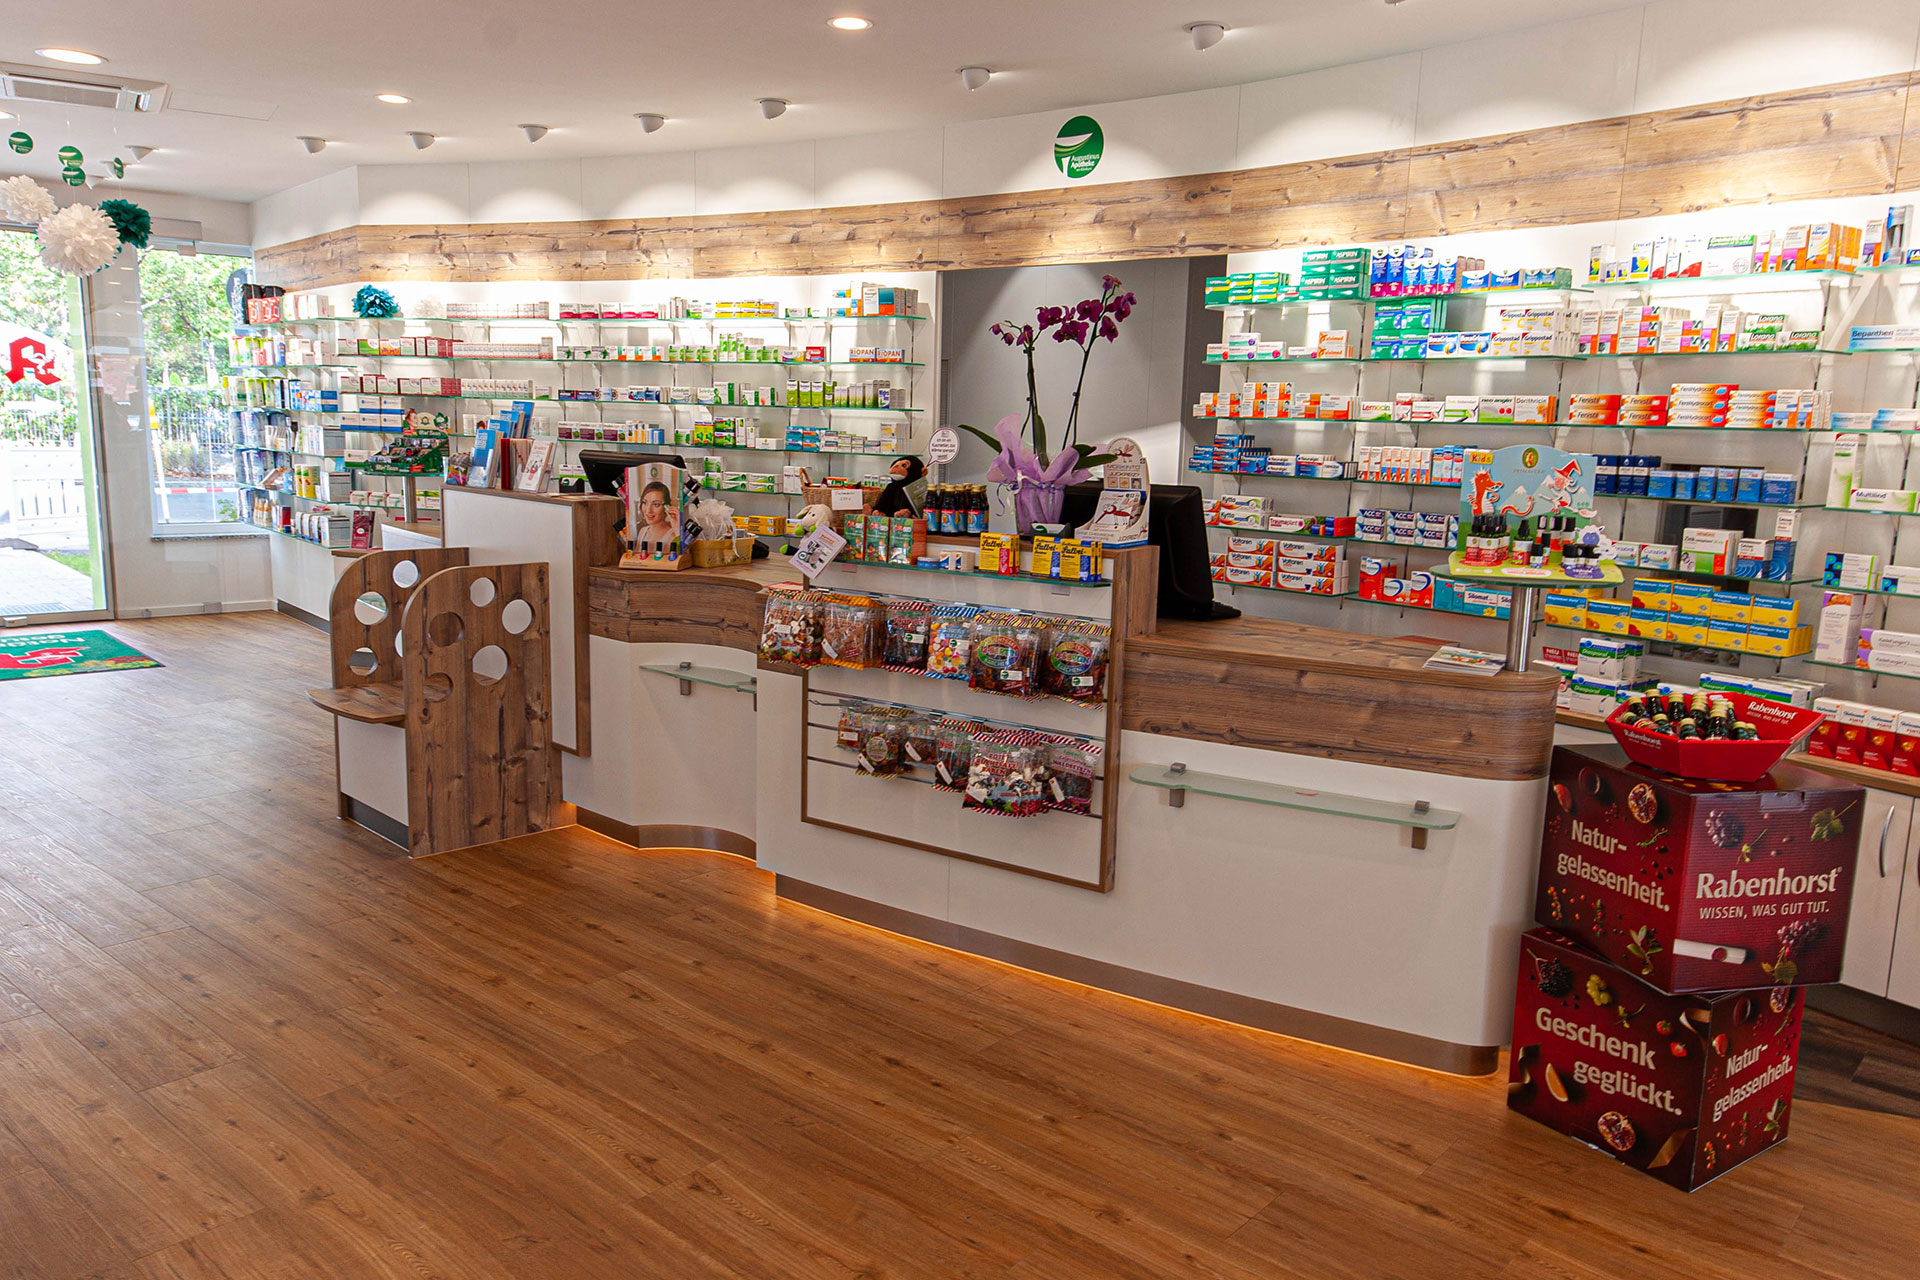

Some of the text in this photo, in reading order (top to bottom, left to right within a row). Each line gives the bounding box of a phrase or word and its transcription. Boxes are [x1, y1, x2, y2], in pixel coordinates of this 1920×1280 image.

[1502, 310, 1525, 319] Gripposta
[1528, 310, 1555, 319] Grippostad
[1524, 334, 1552, 342] Grippostad
[1790, 331, 1817, 339] Lorano
[1851, 330, 1894, 338] Bepanthen
[1493, 335, 1520, 343] Grippostad
[1578, 396, 1600, 404] Fenistil
[1630, 398, 1652, 406] Fenistil
[1361, 403, 1391, 412] Lemocin
[1577, 411, 1598, 419] Fenistil
[1629, 412, 1651, 420] Fenistil
[1855, 491, 1887, 500] Multilind
[1231, 537, 1252, 545] Voltaren
[1282, 542, 1304, 550] Voltaren
[1231, 552, 1251, 560] Voltaren
[1282, 557, 1304, 566] Voltaren
[1230, 567, 1250, 576] Voltaren
[1281, 573, 1303, 581] Voltaren
[1468, 592, 1489, 600] Silomat
[1582, 648, 1608, 657] Diasporal
[1574, 685, 1600, 694] Diasporal
[1748, 701, 1798, 720] Rabenhorst
[1571, 819, 1627, 854] Natur-
[1557, 852, 1670, 912] gelassenheit.
[1696, 867, 1838, 900] Rabenhorst
[1699, 900, 1830, 920] WISSEN, WAS GUT TUT.
[1536, 1008, 1656, 1070] Geschenk
[1726, 1044, 1768, 1079] Natur-
[1573, 1059, 1682, 1116] geglückt.
[1712, 1055, 1793, 1122] gelassenheit.
